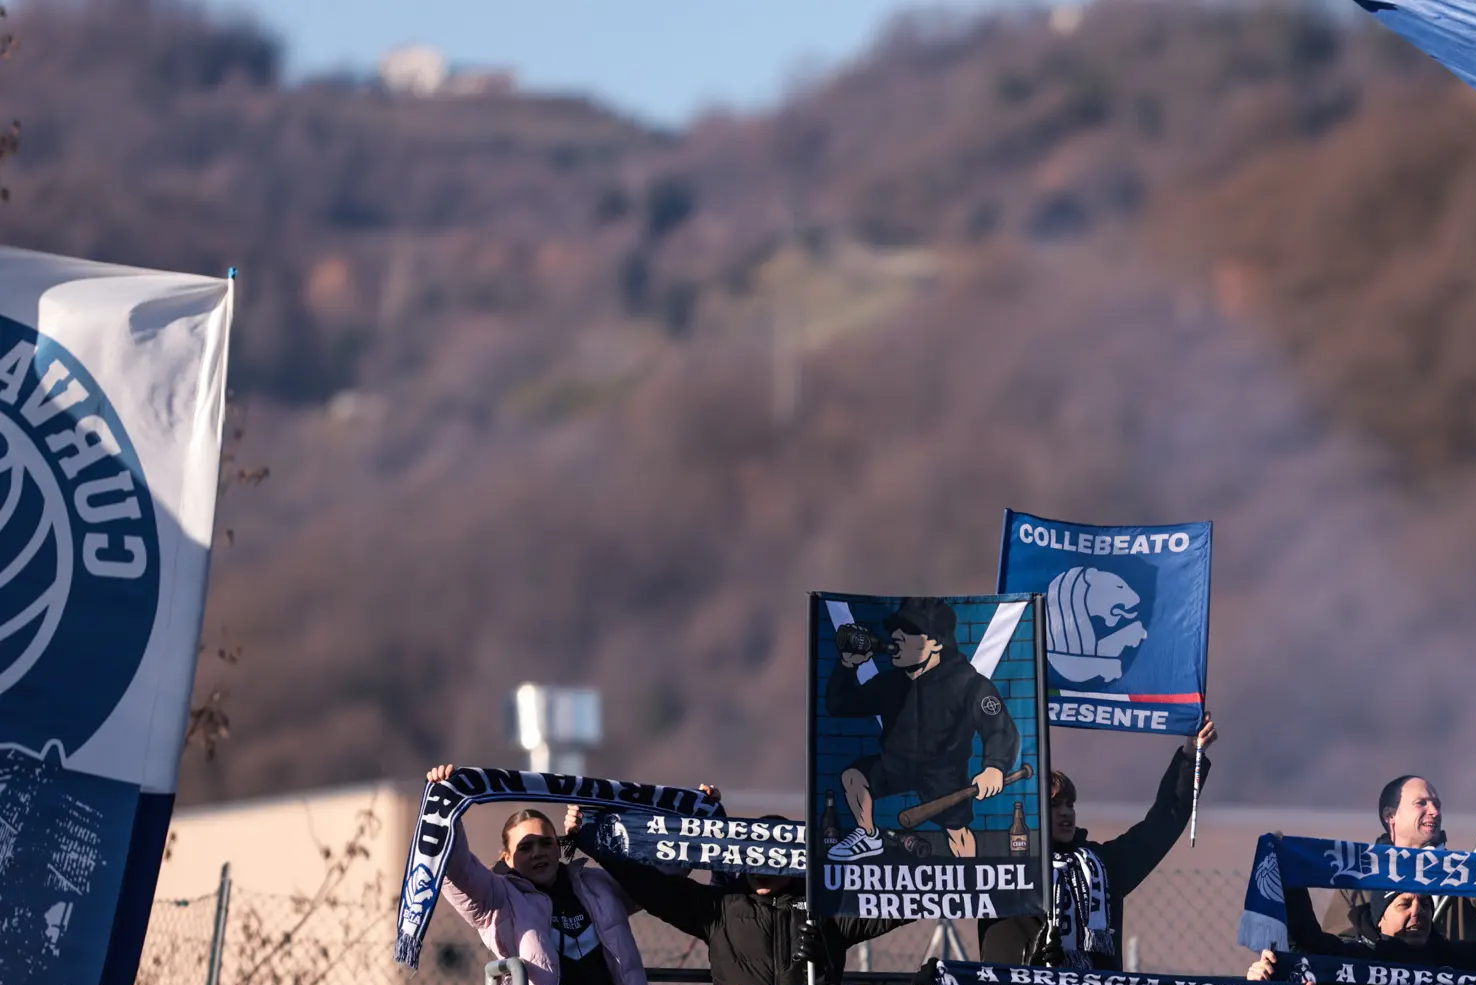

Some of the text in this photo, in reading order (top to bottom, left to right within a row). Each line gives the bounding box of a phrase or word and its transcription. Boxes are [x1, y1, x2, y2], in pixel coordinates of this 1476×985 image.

[1018, 523, 1190, 555] COLLEBEATO
[1048, 702, 1169, 731] RESENTE
[647, 816, 806, 843] A BRESCI
[656, 841, 806, 870] SI PASSE
[823, 864, 1034, 891] UBRIACHI DEL
[858, 892, 998, 919] BRESCIA
[976, 967, 991, 984] A
[1336, 963, 1357, 984] A
